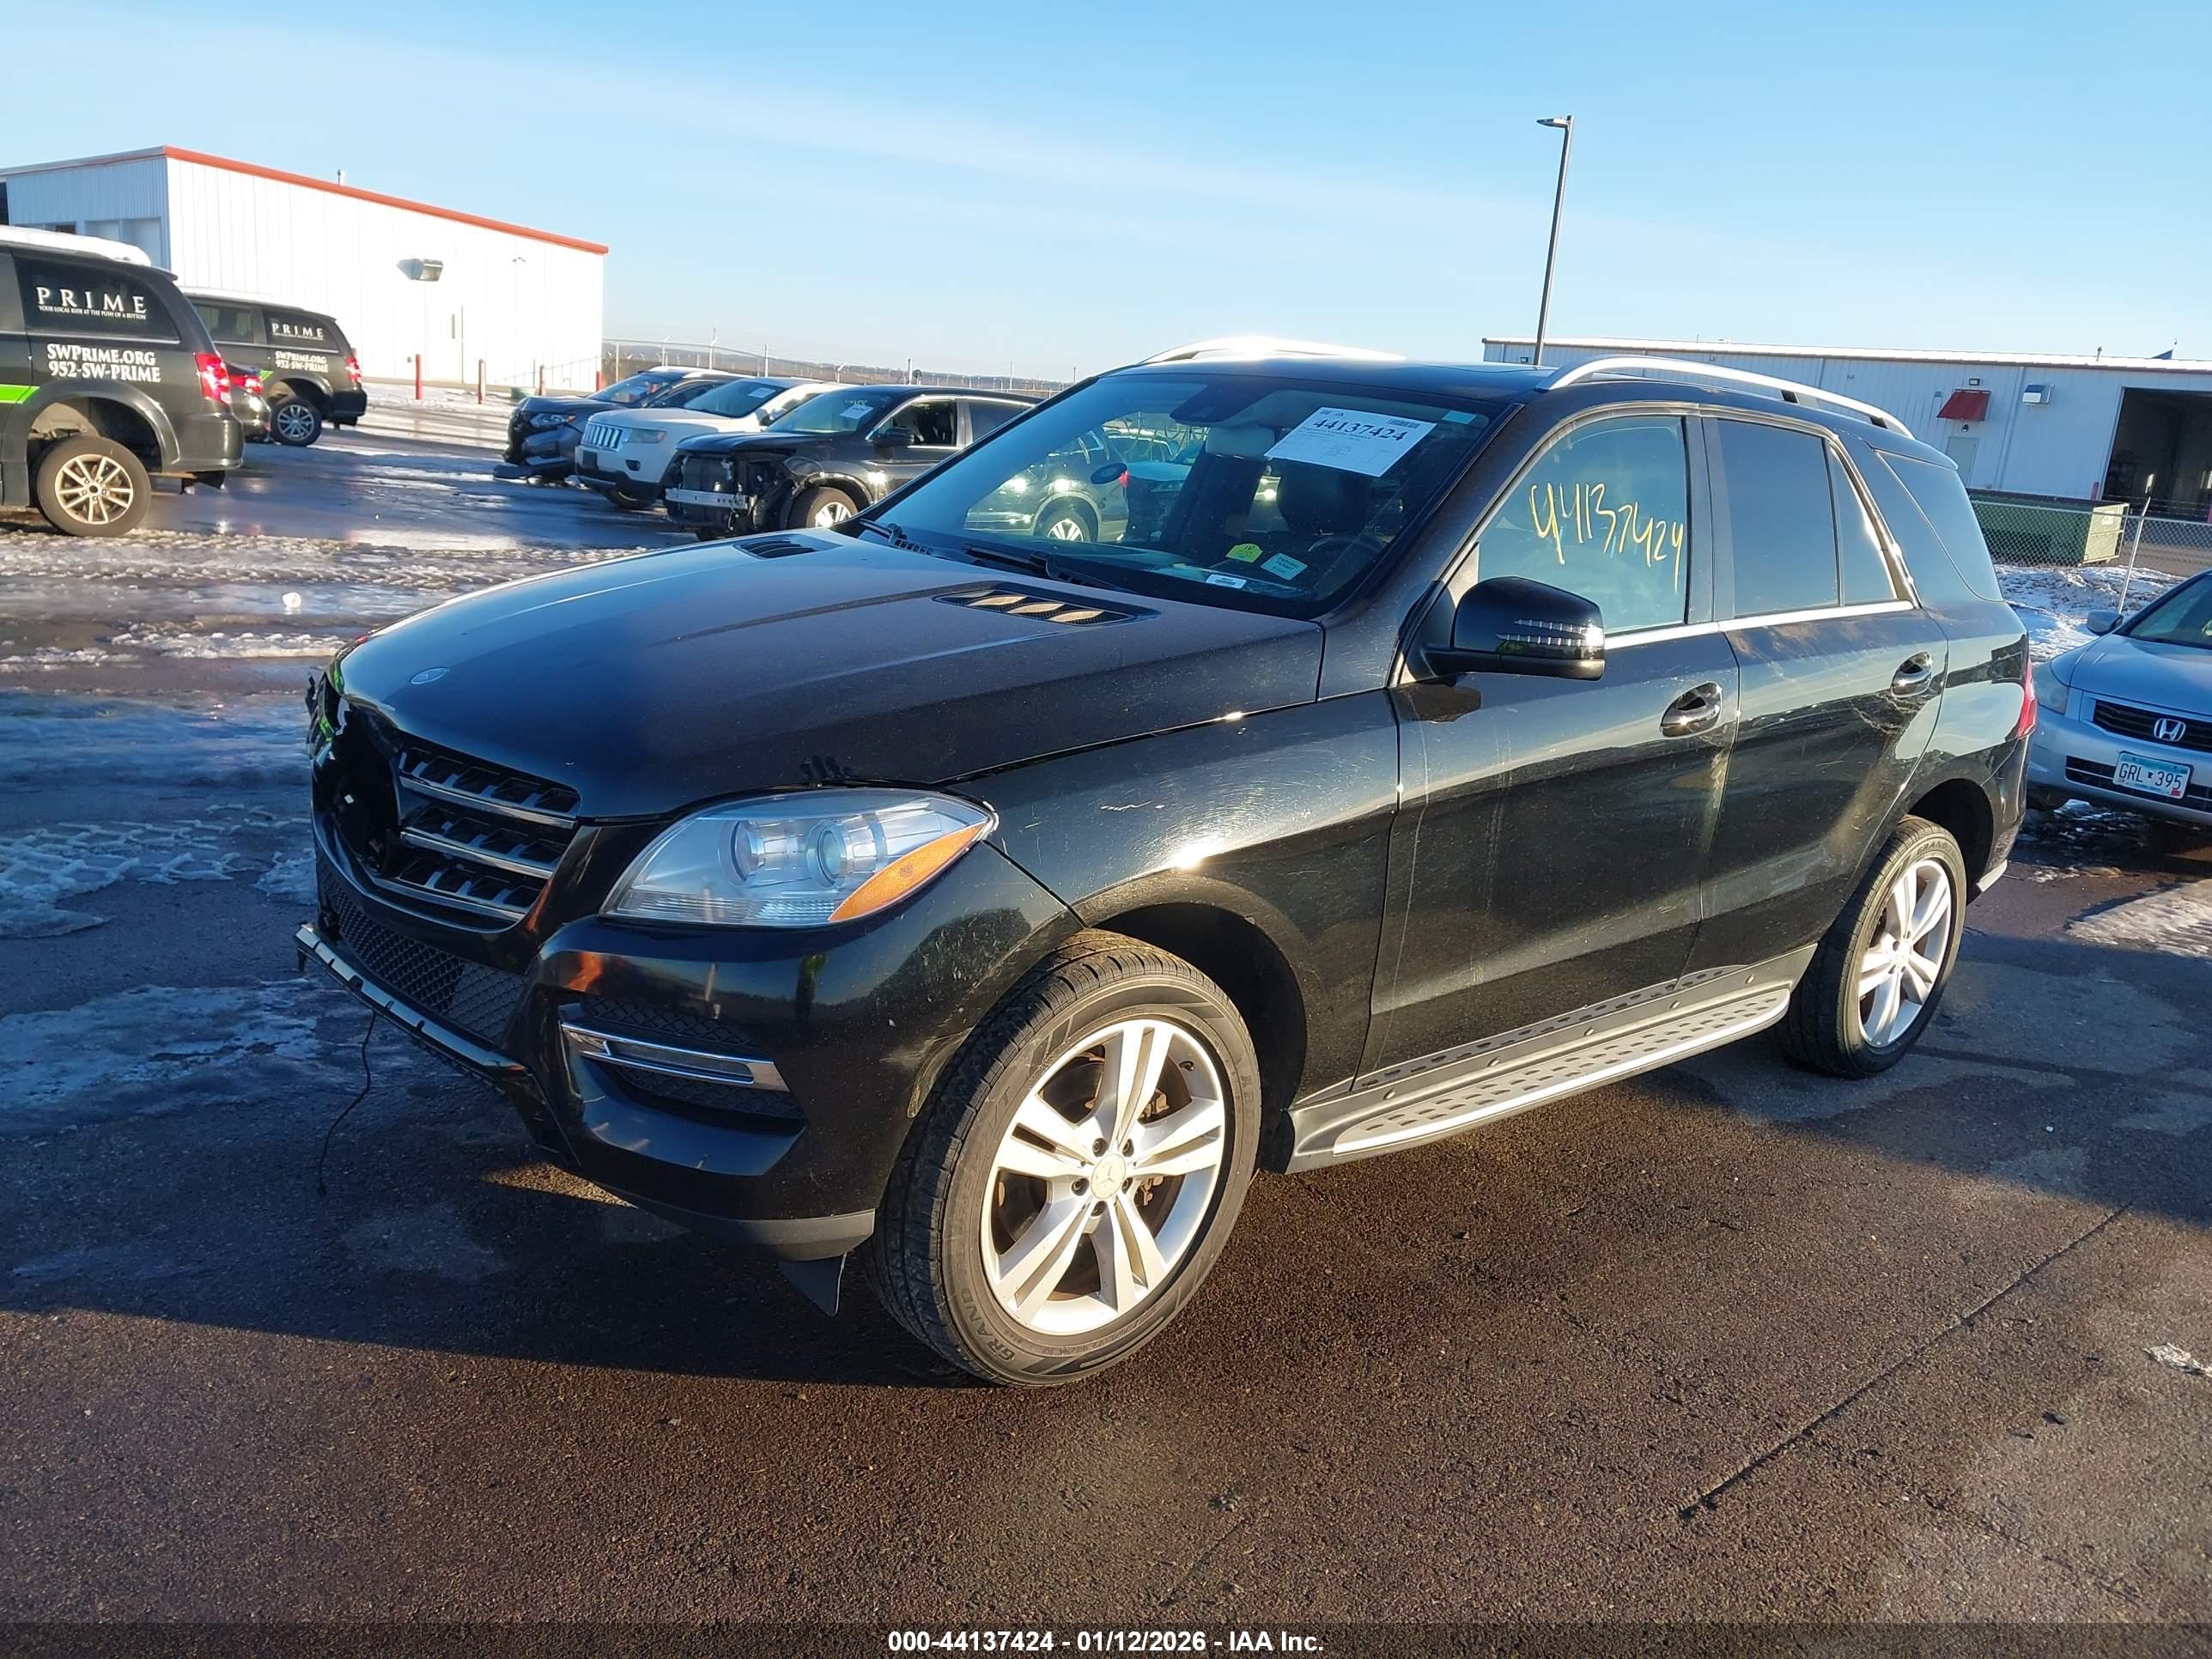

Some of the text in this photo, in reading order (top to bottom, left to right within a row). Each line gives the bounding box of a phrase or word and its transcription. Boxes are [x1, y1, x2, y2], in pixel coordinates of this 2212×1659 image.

[36, 287, 147, 313] PRIME
[271, 323, 324, 337] PRIME
[46, 343, 156, 366] SWPRIME.ORG
[275, 350, 326, 364] SWPRIME.ORG
[48, 361, 161, 382] 952-SW-PRIME
[276, 360, 329, 373] 952-SW-PRIME
[1313, 418, 1409, 441] 44137424
[1529, 483, 1684, 592] 44137424
[2118, 763, 2143, 782] GRL
[2154, 771, 2184, 790] 395
[961, 1288, 1016, 1361] GRAND
